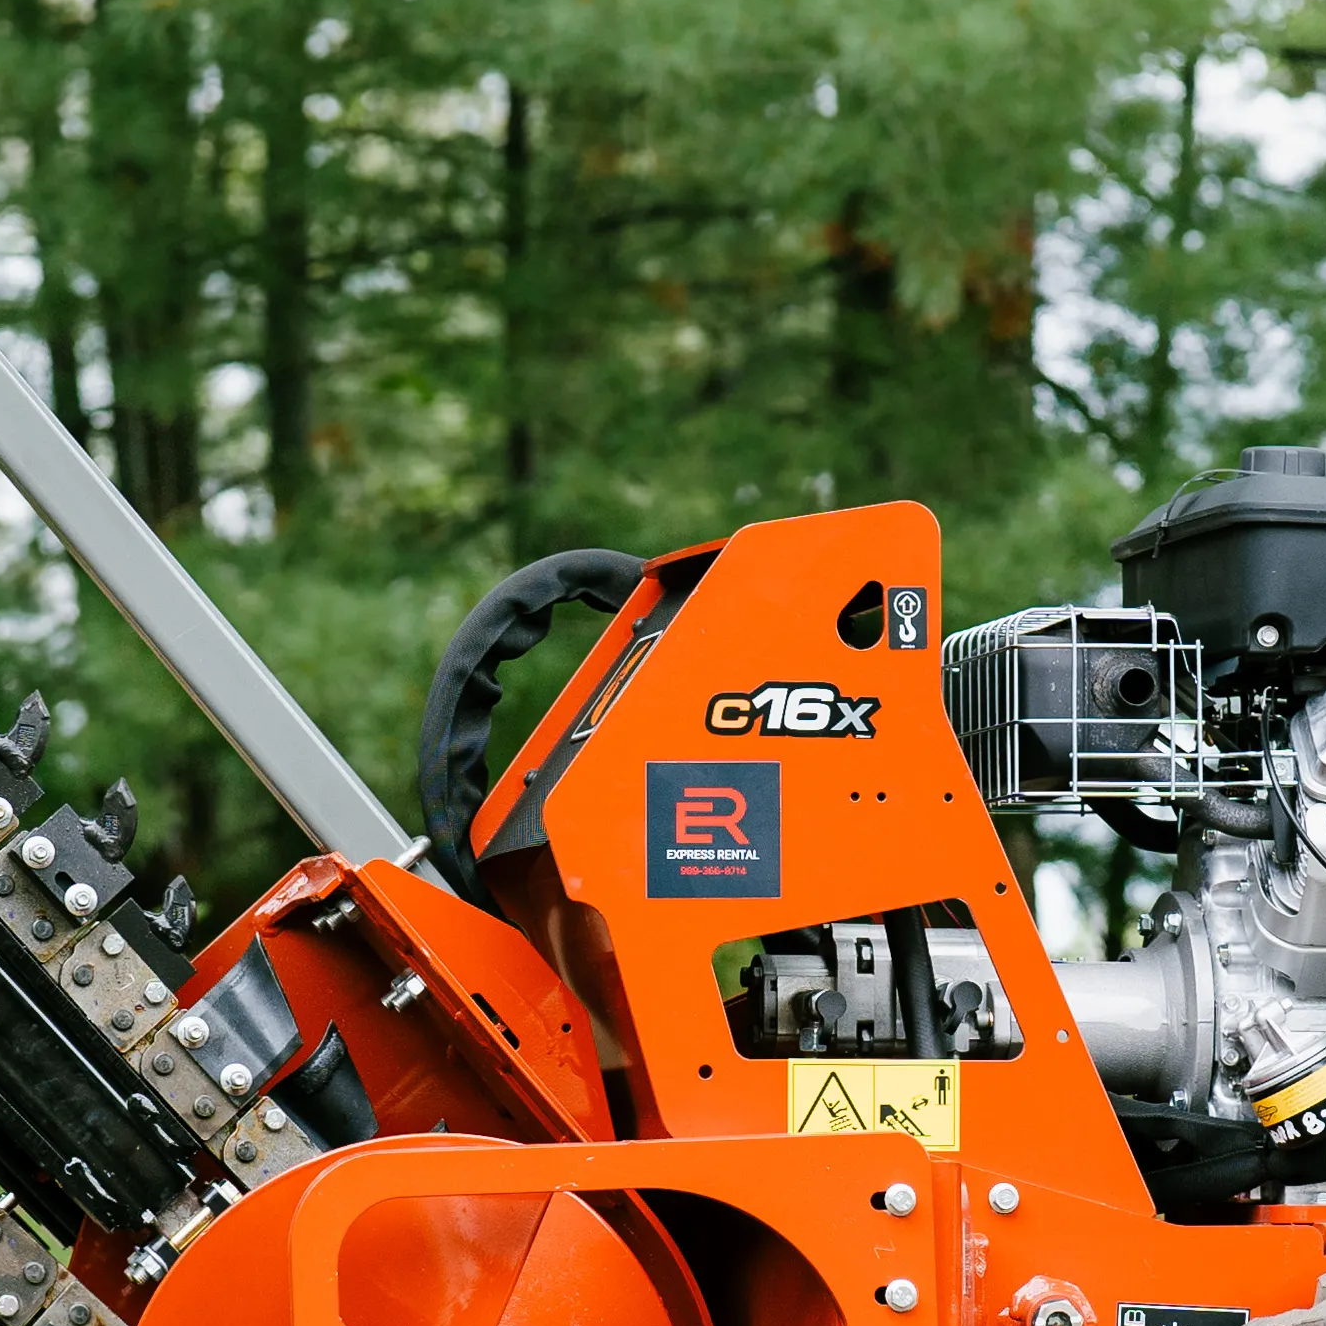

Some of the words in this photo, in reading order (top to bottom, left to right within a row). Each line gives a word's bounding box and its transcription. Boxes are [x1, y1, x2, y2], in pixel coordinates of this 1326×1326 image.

[676, 786, 750, 845] ER
[666, 849, 716, 860] EXPRESS
[716, 849, 760, 860] RENTAL
